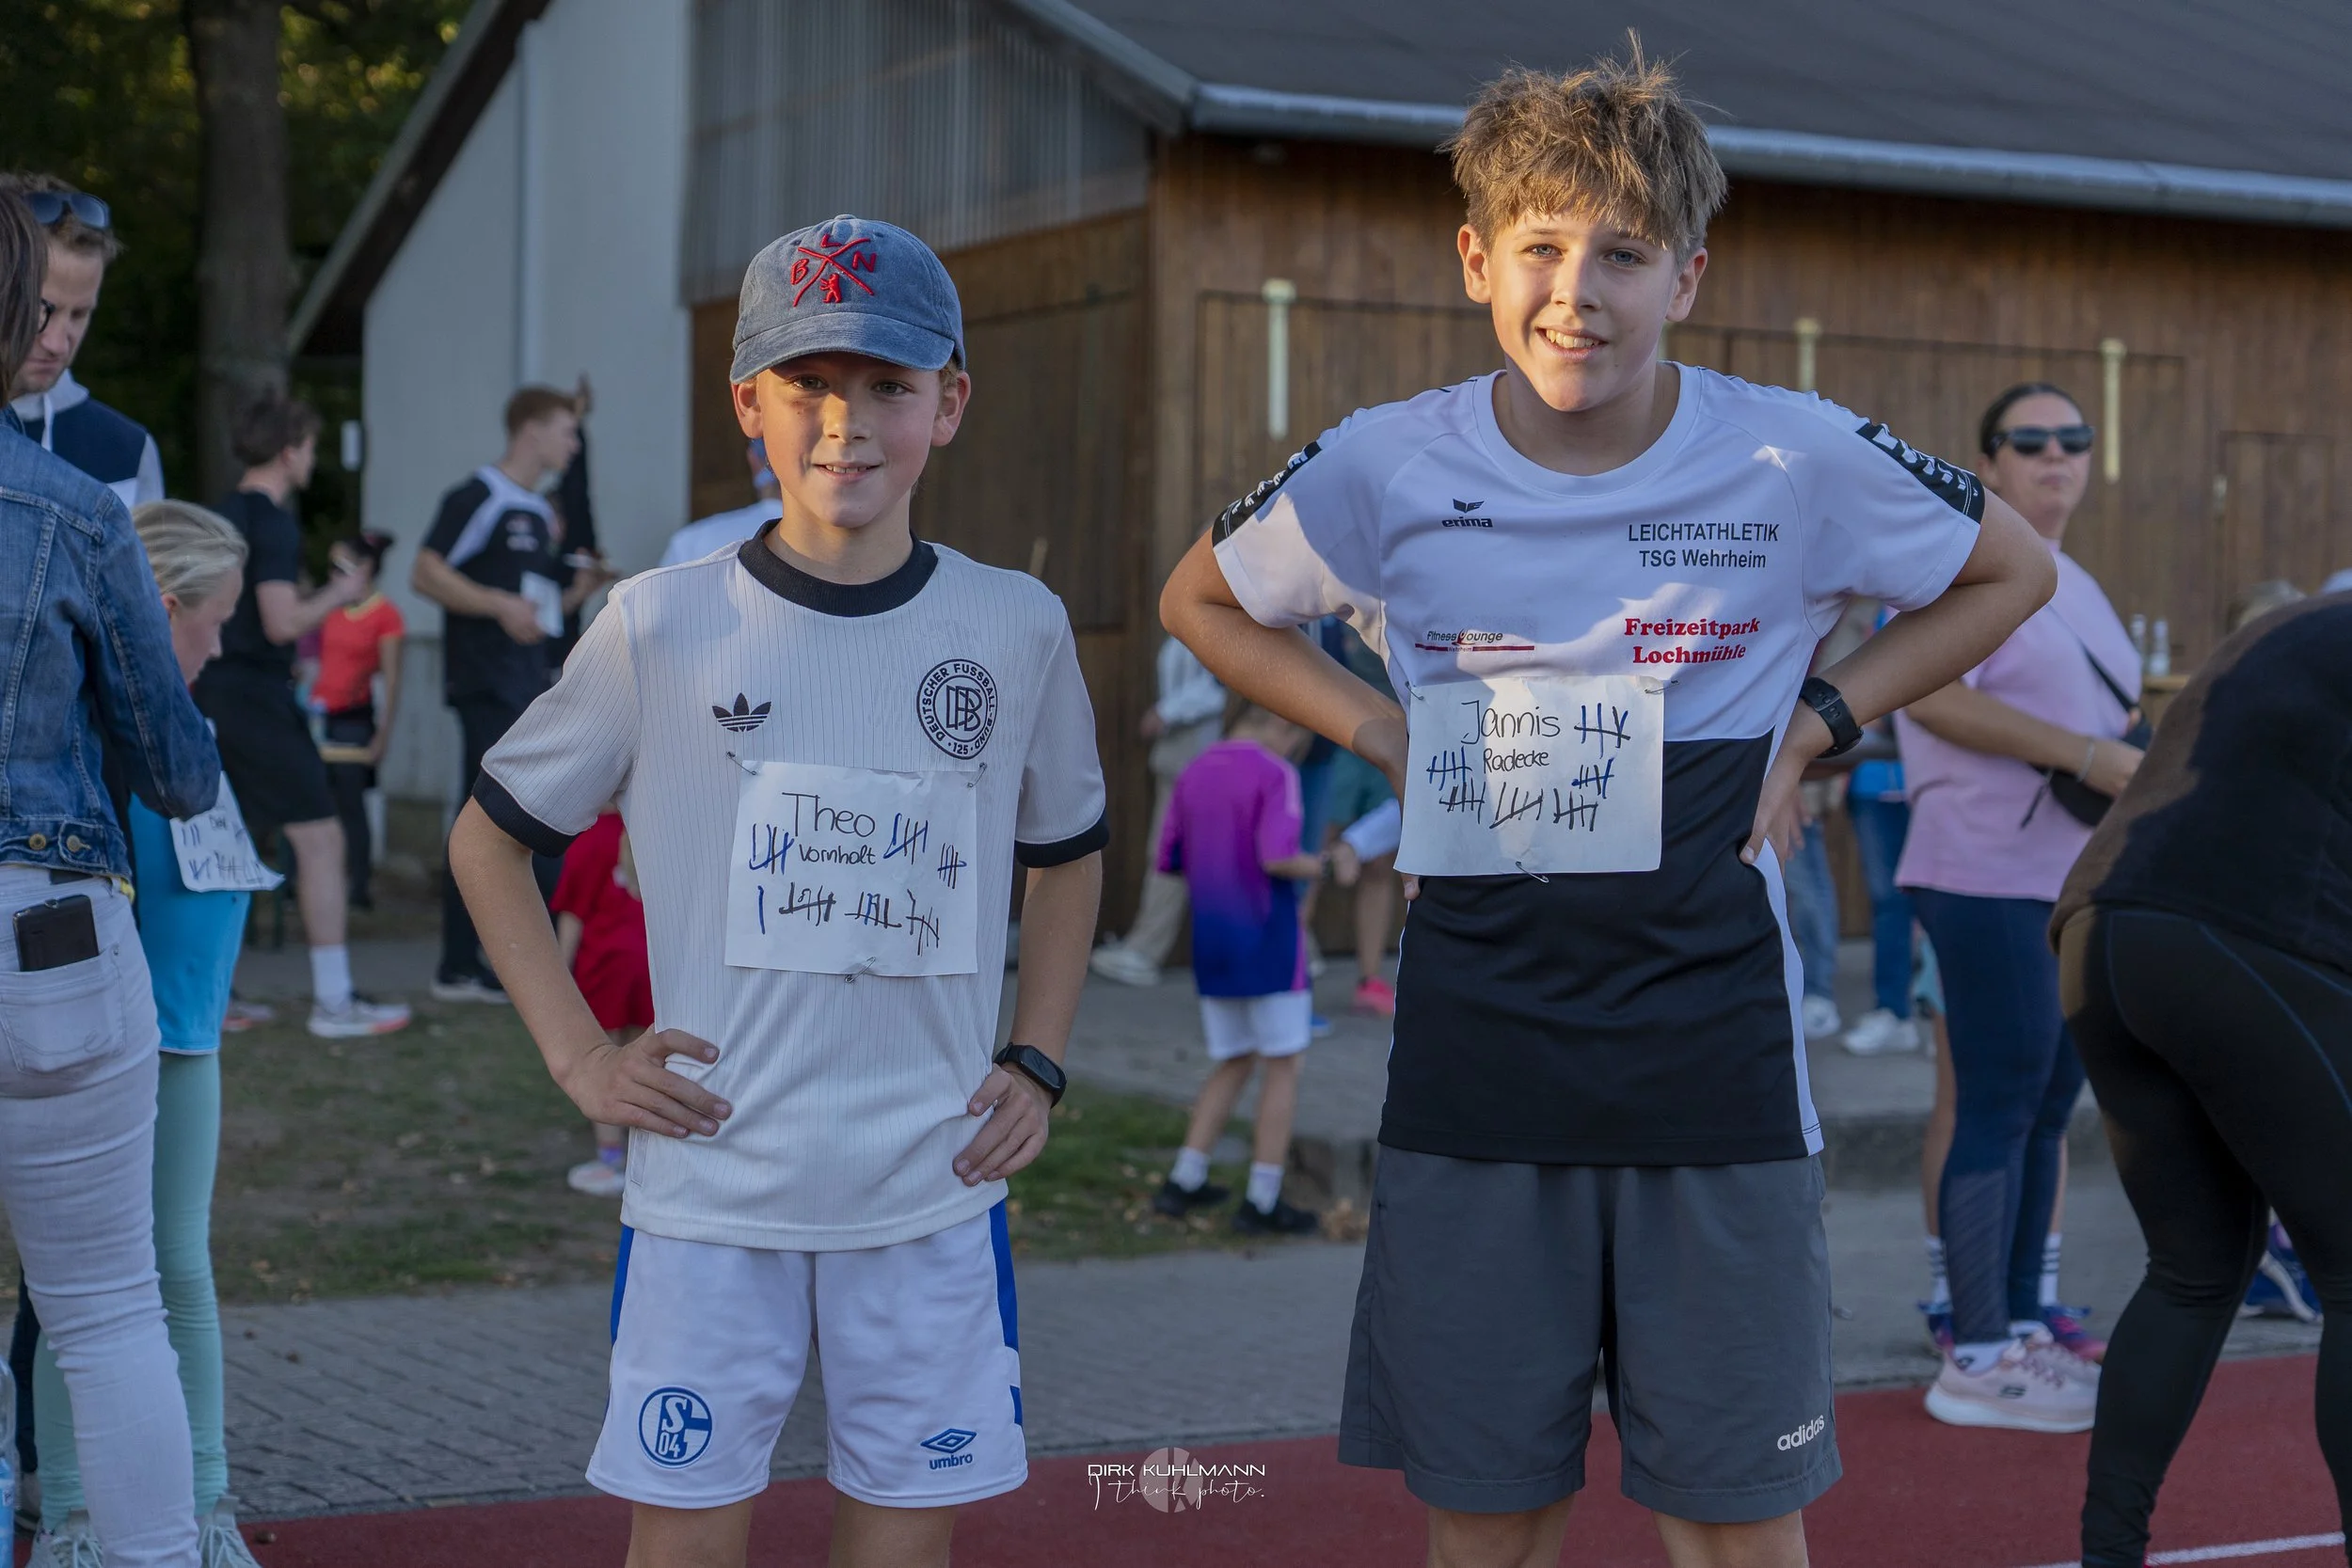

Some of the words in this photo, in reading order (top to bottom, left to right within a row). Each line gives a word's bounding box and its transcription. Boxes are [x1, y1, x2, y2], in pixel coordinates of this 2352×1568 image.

[1441, 516, 1494, 528] erima
[1629, 523, 1780, 542] LEICHTATHLETIK
[1639, 549, 1677, 567] TSG
[1682, 548, 1767, 568] Wehrheim
[1624, 618, 1761, 640] Freizeitpark
[1632, 643, 1746, 663] Lochmühle
[923, 667, 950, 742] DEUTSCHER
[1460, 700, 1561, 745] Jannis
[1483, 748, 1550, 774] Radecke
[782, 792, 876, 838] Theo
[799, 844, 877, 865] Vornholt
[1777, 1414, 1825, 1451] adidas
[929, 1453, 973, 1470] umbro
